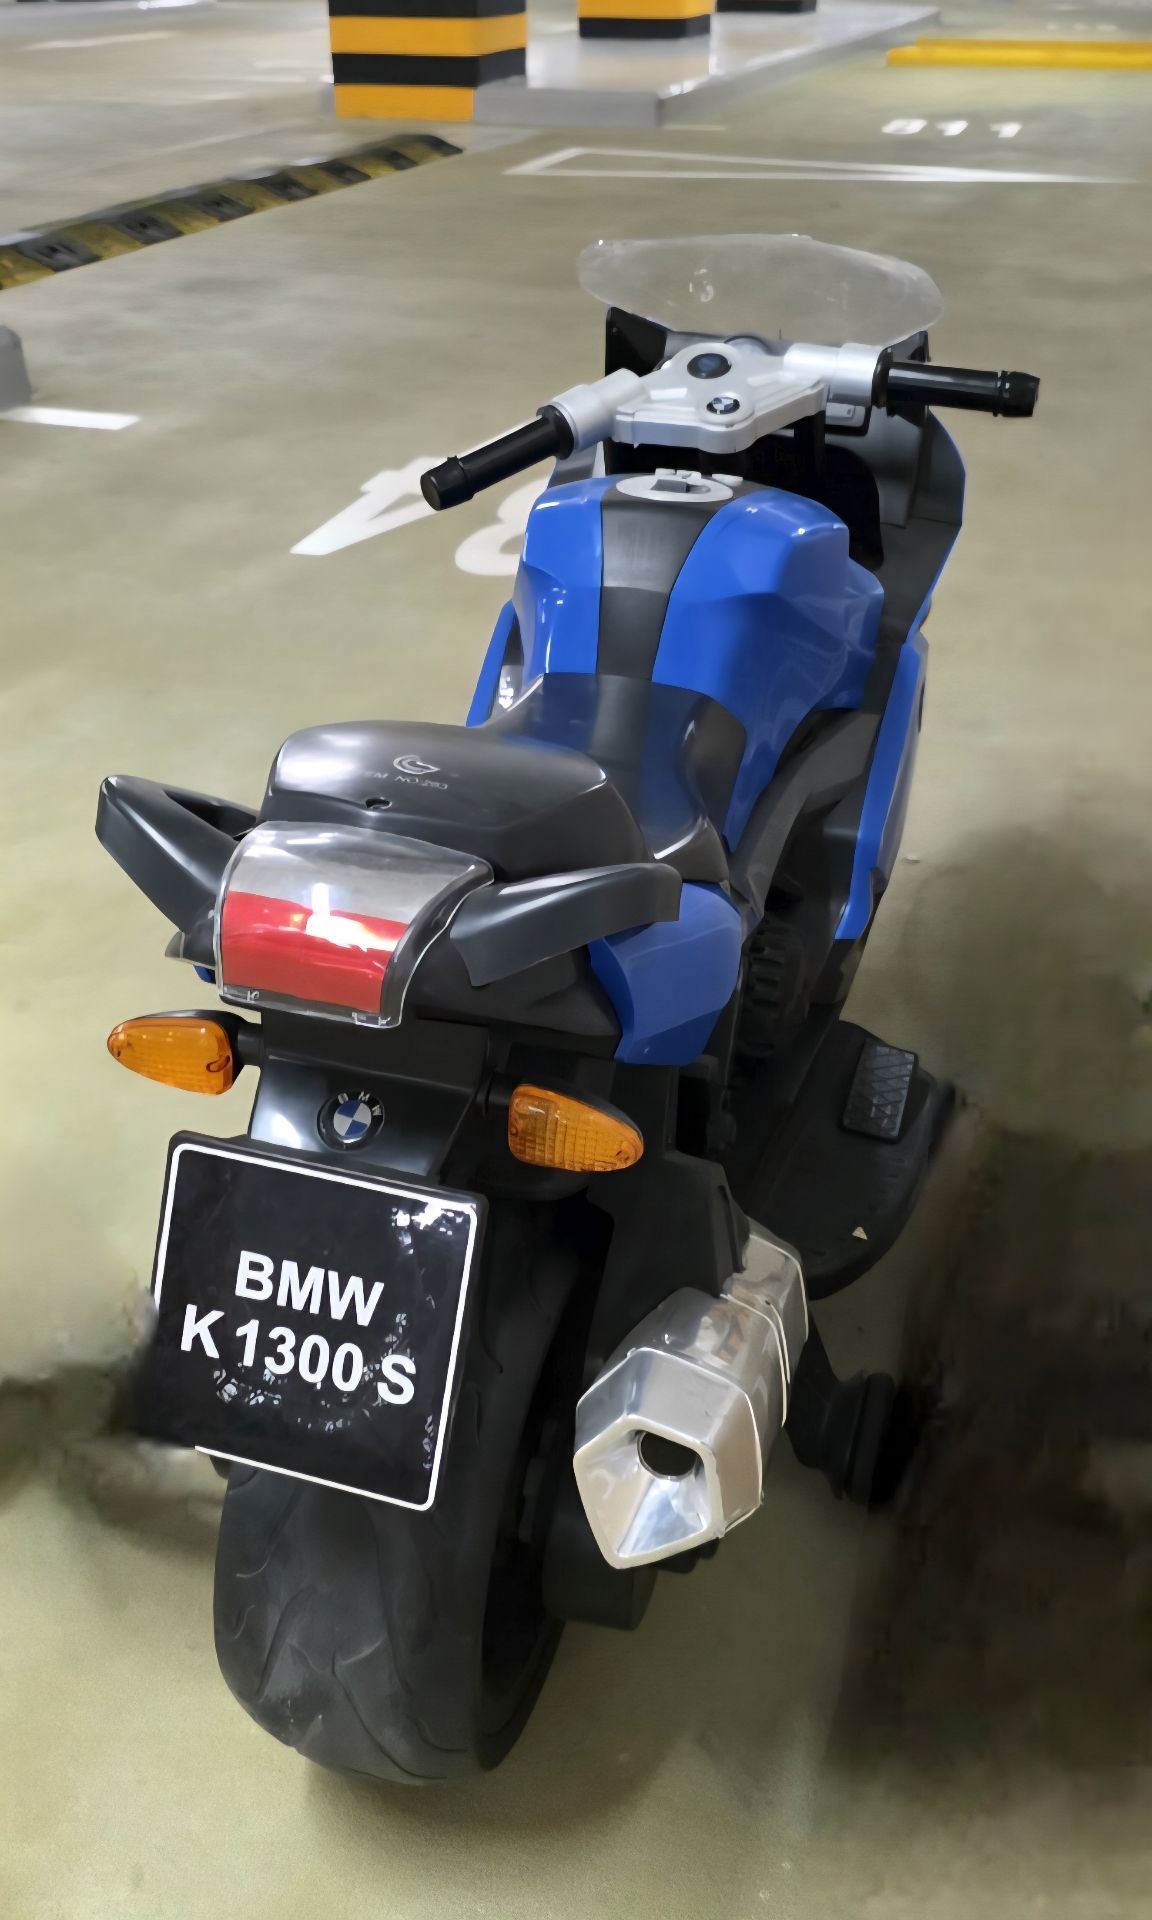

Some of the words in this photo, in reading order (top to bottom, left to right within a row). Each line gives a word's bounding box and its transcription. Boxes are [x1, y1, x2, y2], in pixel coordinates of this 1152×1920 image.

[234, 1249, 385, 1327] BMW
[179, 1303, 225, 1360] K
[234, 1318, 364, 1392] 1300
[377, 1354, 417, 1405] S
